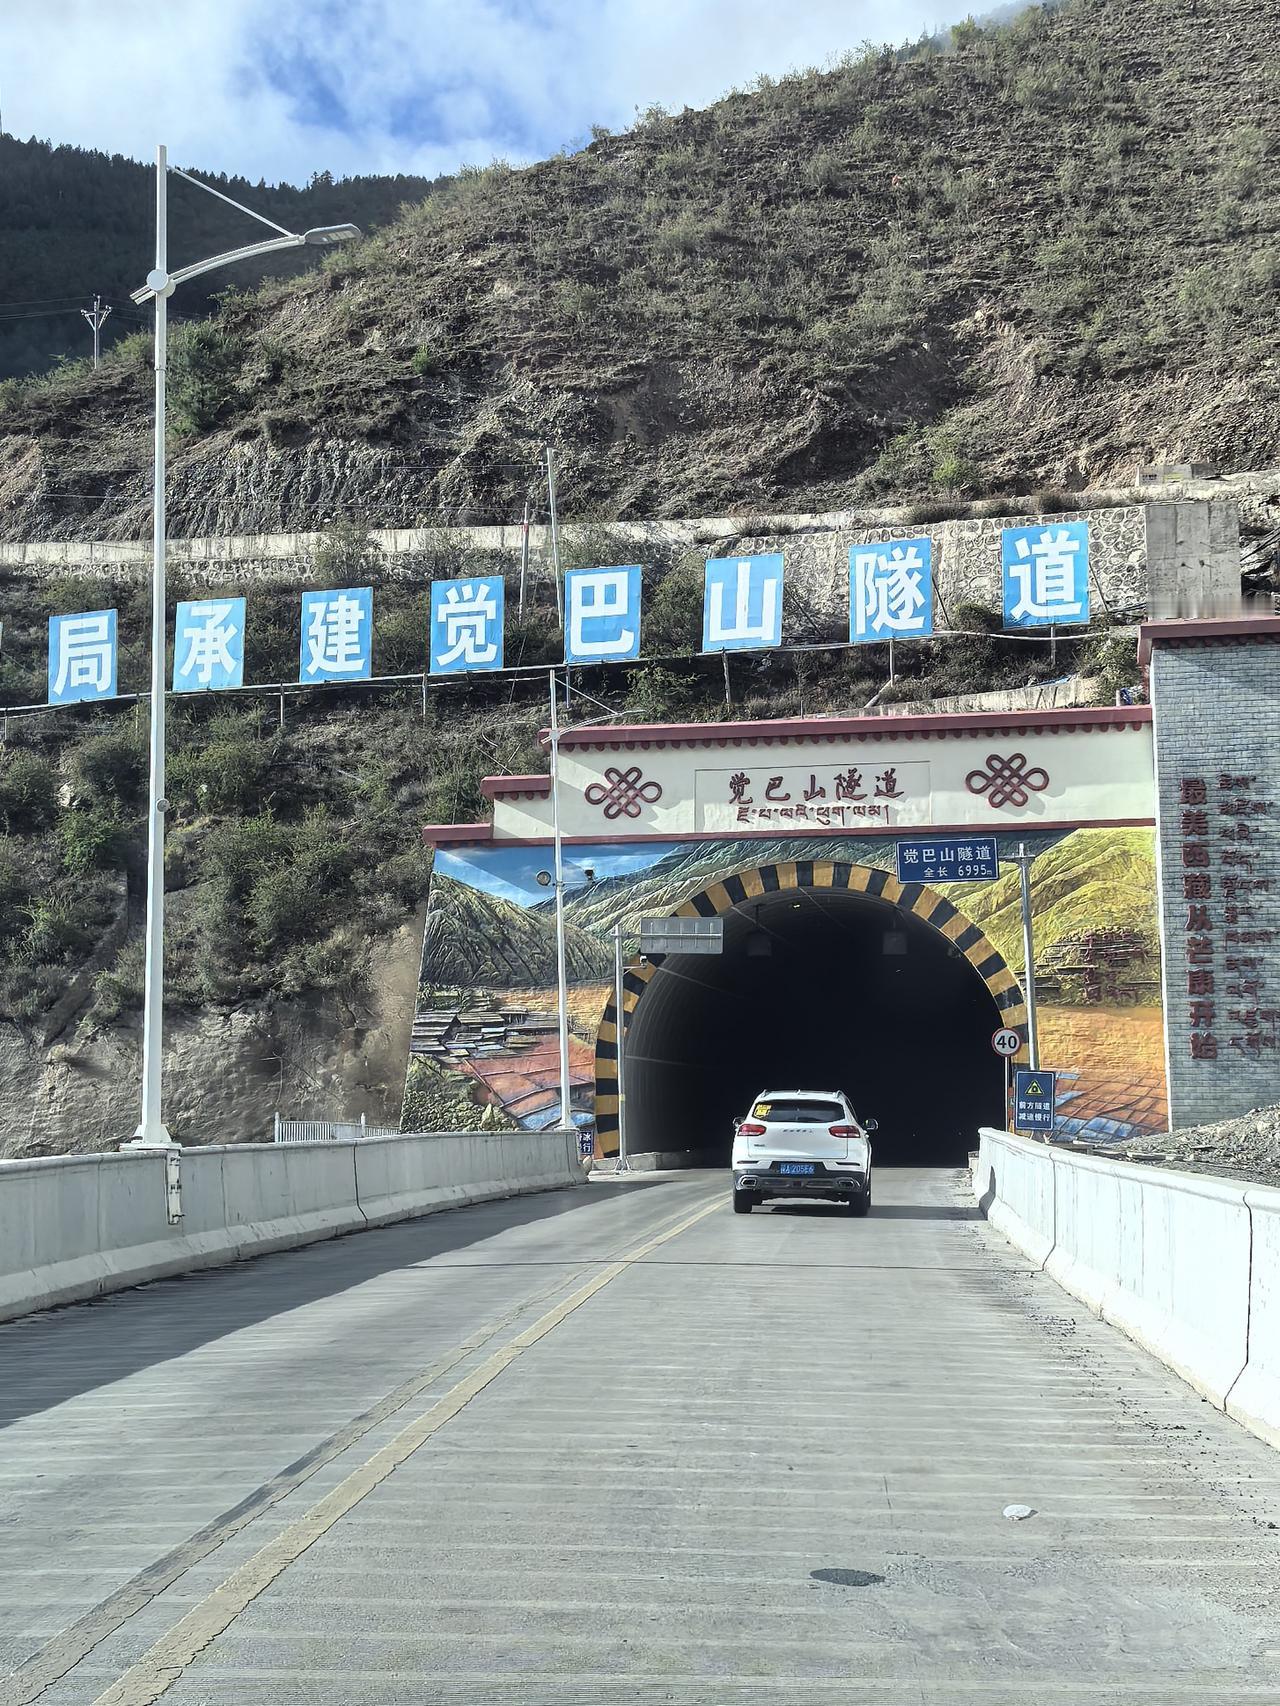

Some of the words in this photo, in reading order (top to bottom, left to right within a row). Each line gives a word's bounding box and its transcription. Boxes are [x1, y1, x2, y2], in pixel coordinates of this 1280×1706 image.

[729, 768, 905, 804] 觉巴山隧道
[903, 845, 992, 864] 觉巴山隧道
[923, 866, 948, 878] 全长
[1179, 777, 1217, 1060] 最美西藏从芒康开始
[996, 1035, 1017, 1049] 40
[1018, 1101, 1051, 1111] 前方隧道
[1018, 1112, 1051, 1122] 减速慢行
